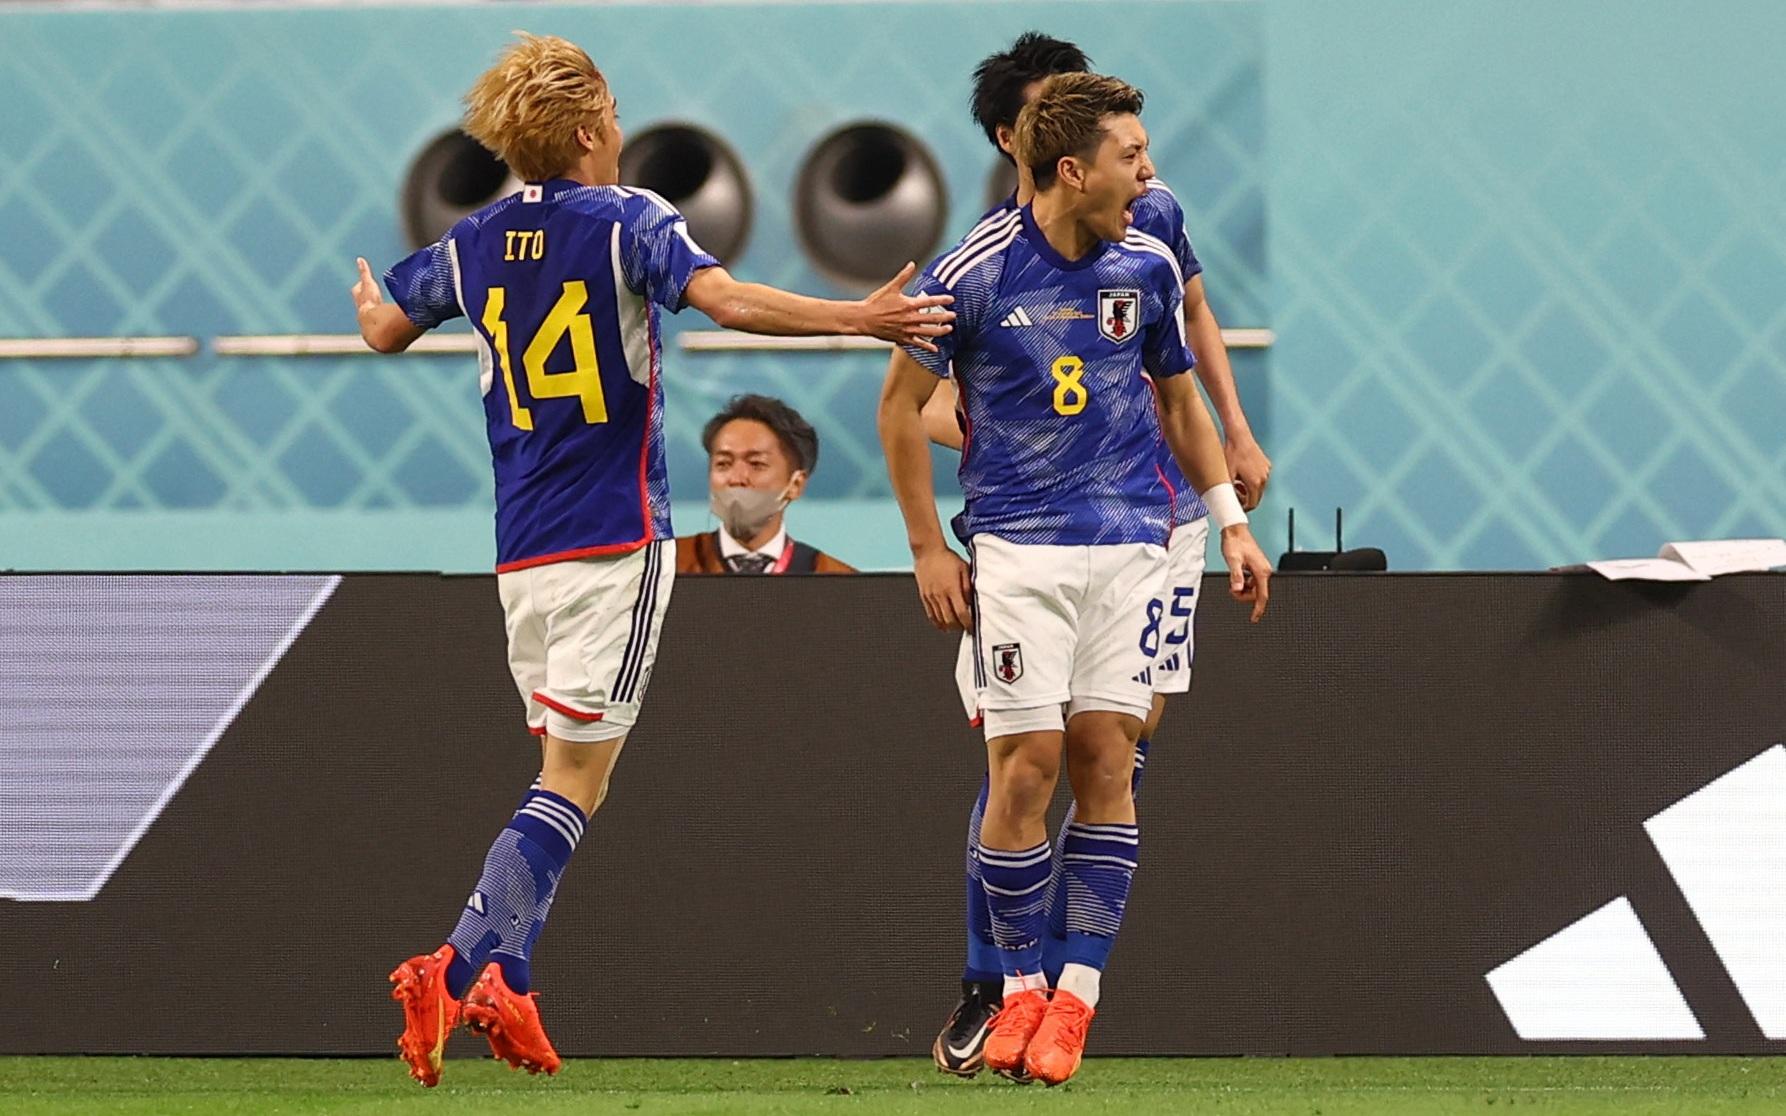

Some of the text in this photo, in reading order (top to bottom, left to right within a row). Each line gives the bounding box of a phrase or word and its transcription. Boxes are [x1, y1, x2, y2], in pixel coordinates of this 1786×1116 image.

[504, 229, 544, 261] ITO
[481, 280, 608, 431] 14
[1051, 355, 1089, 416] 8
[1139, 597, 1164, 659] 8
[1165, 586, 1194, 645] 5
